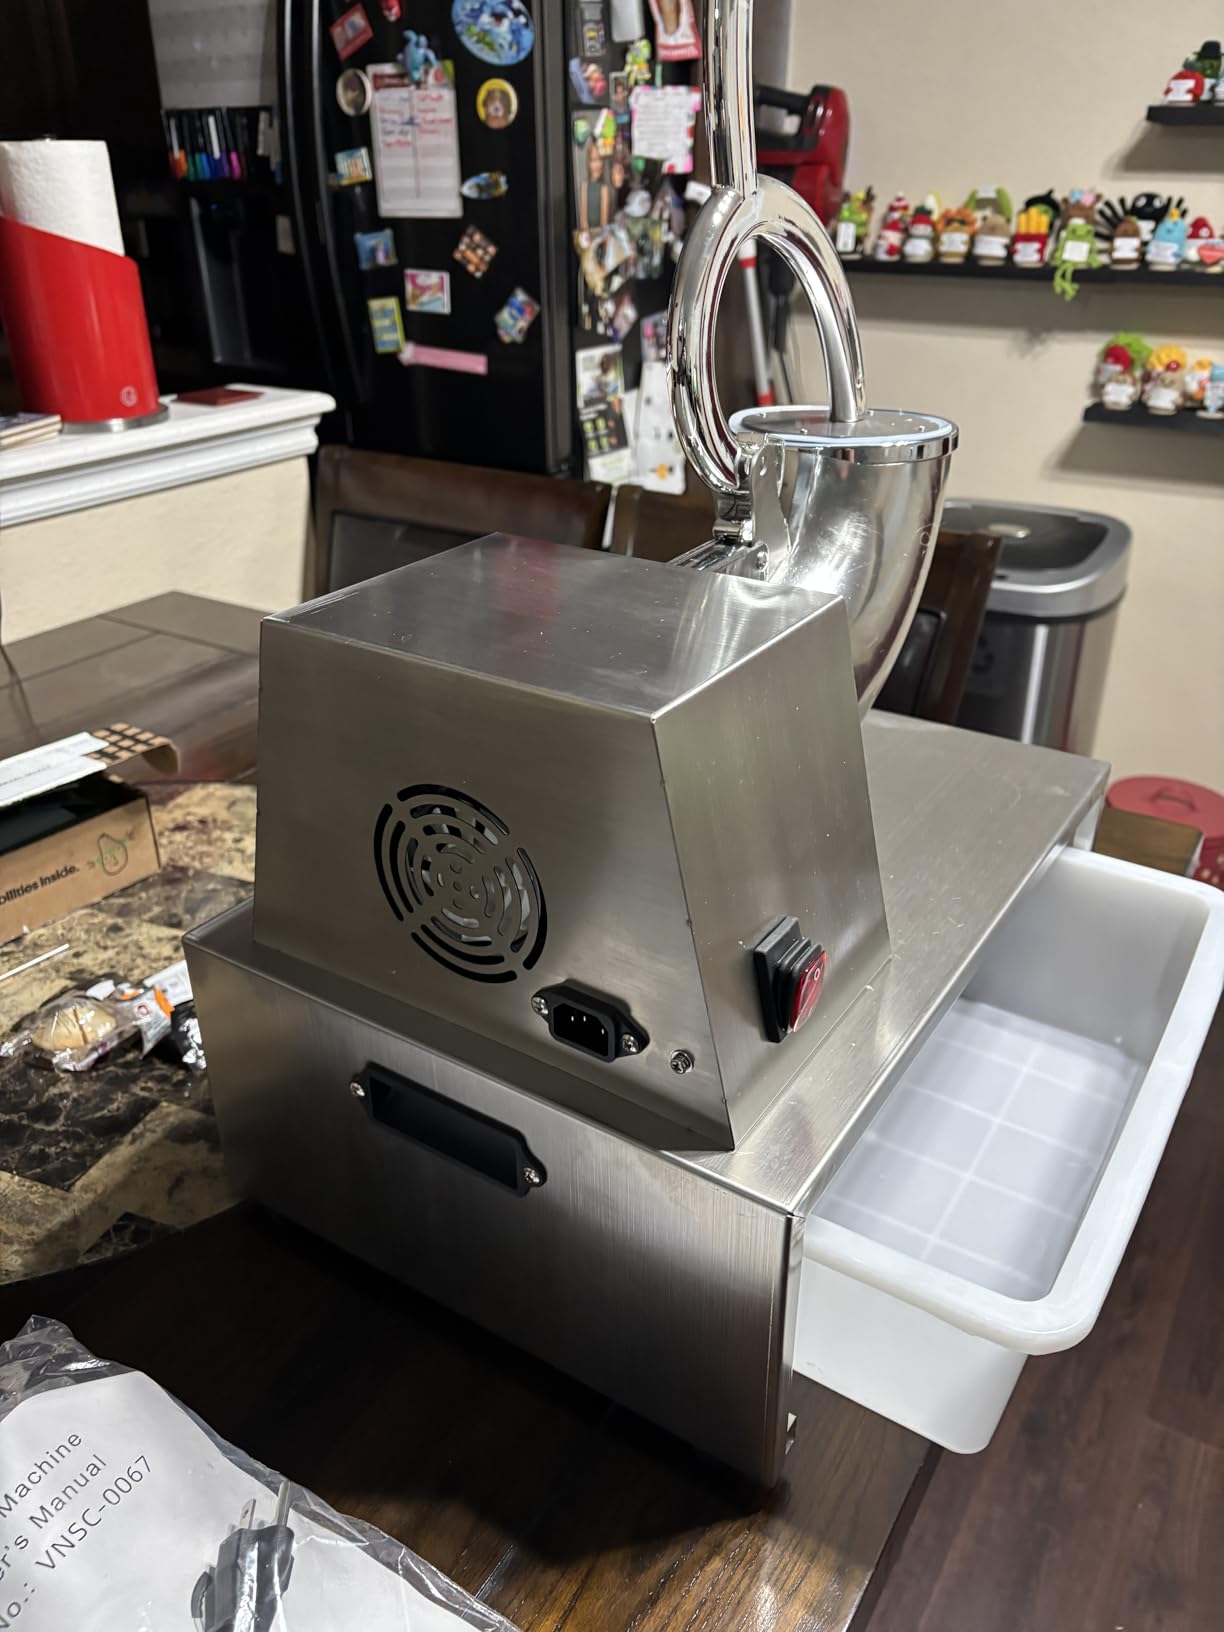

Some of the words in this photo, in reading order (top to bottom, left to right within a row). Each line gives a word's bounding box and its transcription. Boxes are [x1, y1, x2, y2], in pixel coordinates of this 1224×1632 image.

[40, 865, 80, 888] Inside.
[0, 1434, 82, 1518] Machine
[28, 1454, 107, 1529] Manual
[35, 1455, 153, 1569] VNSC-0067
